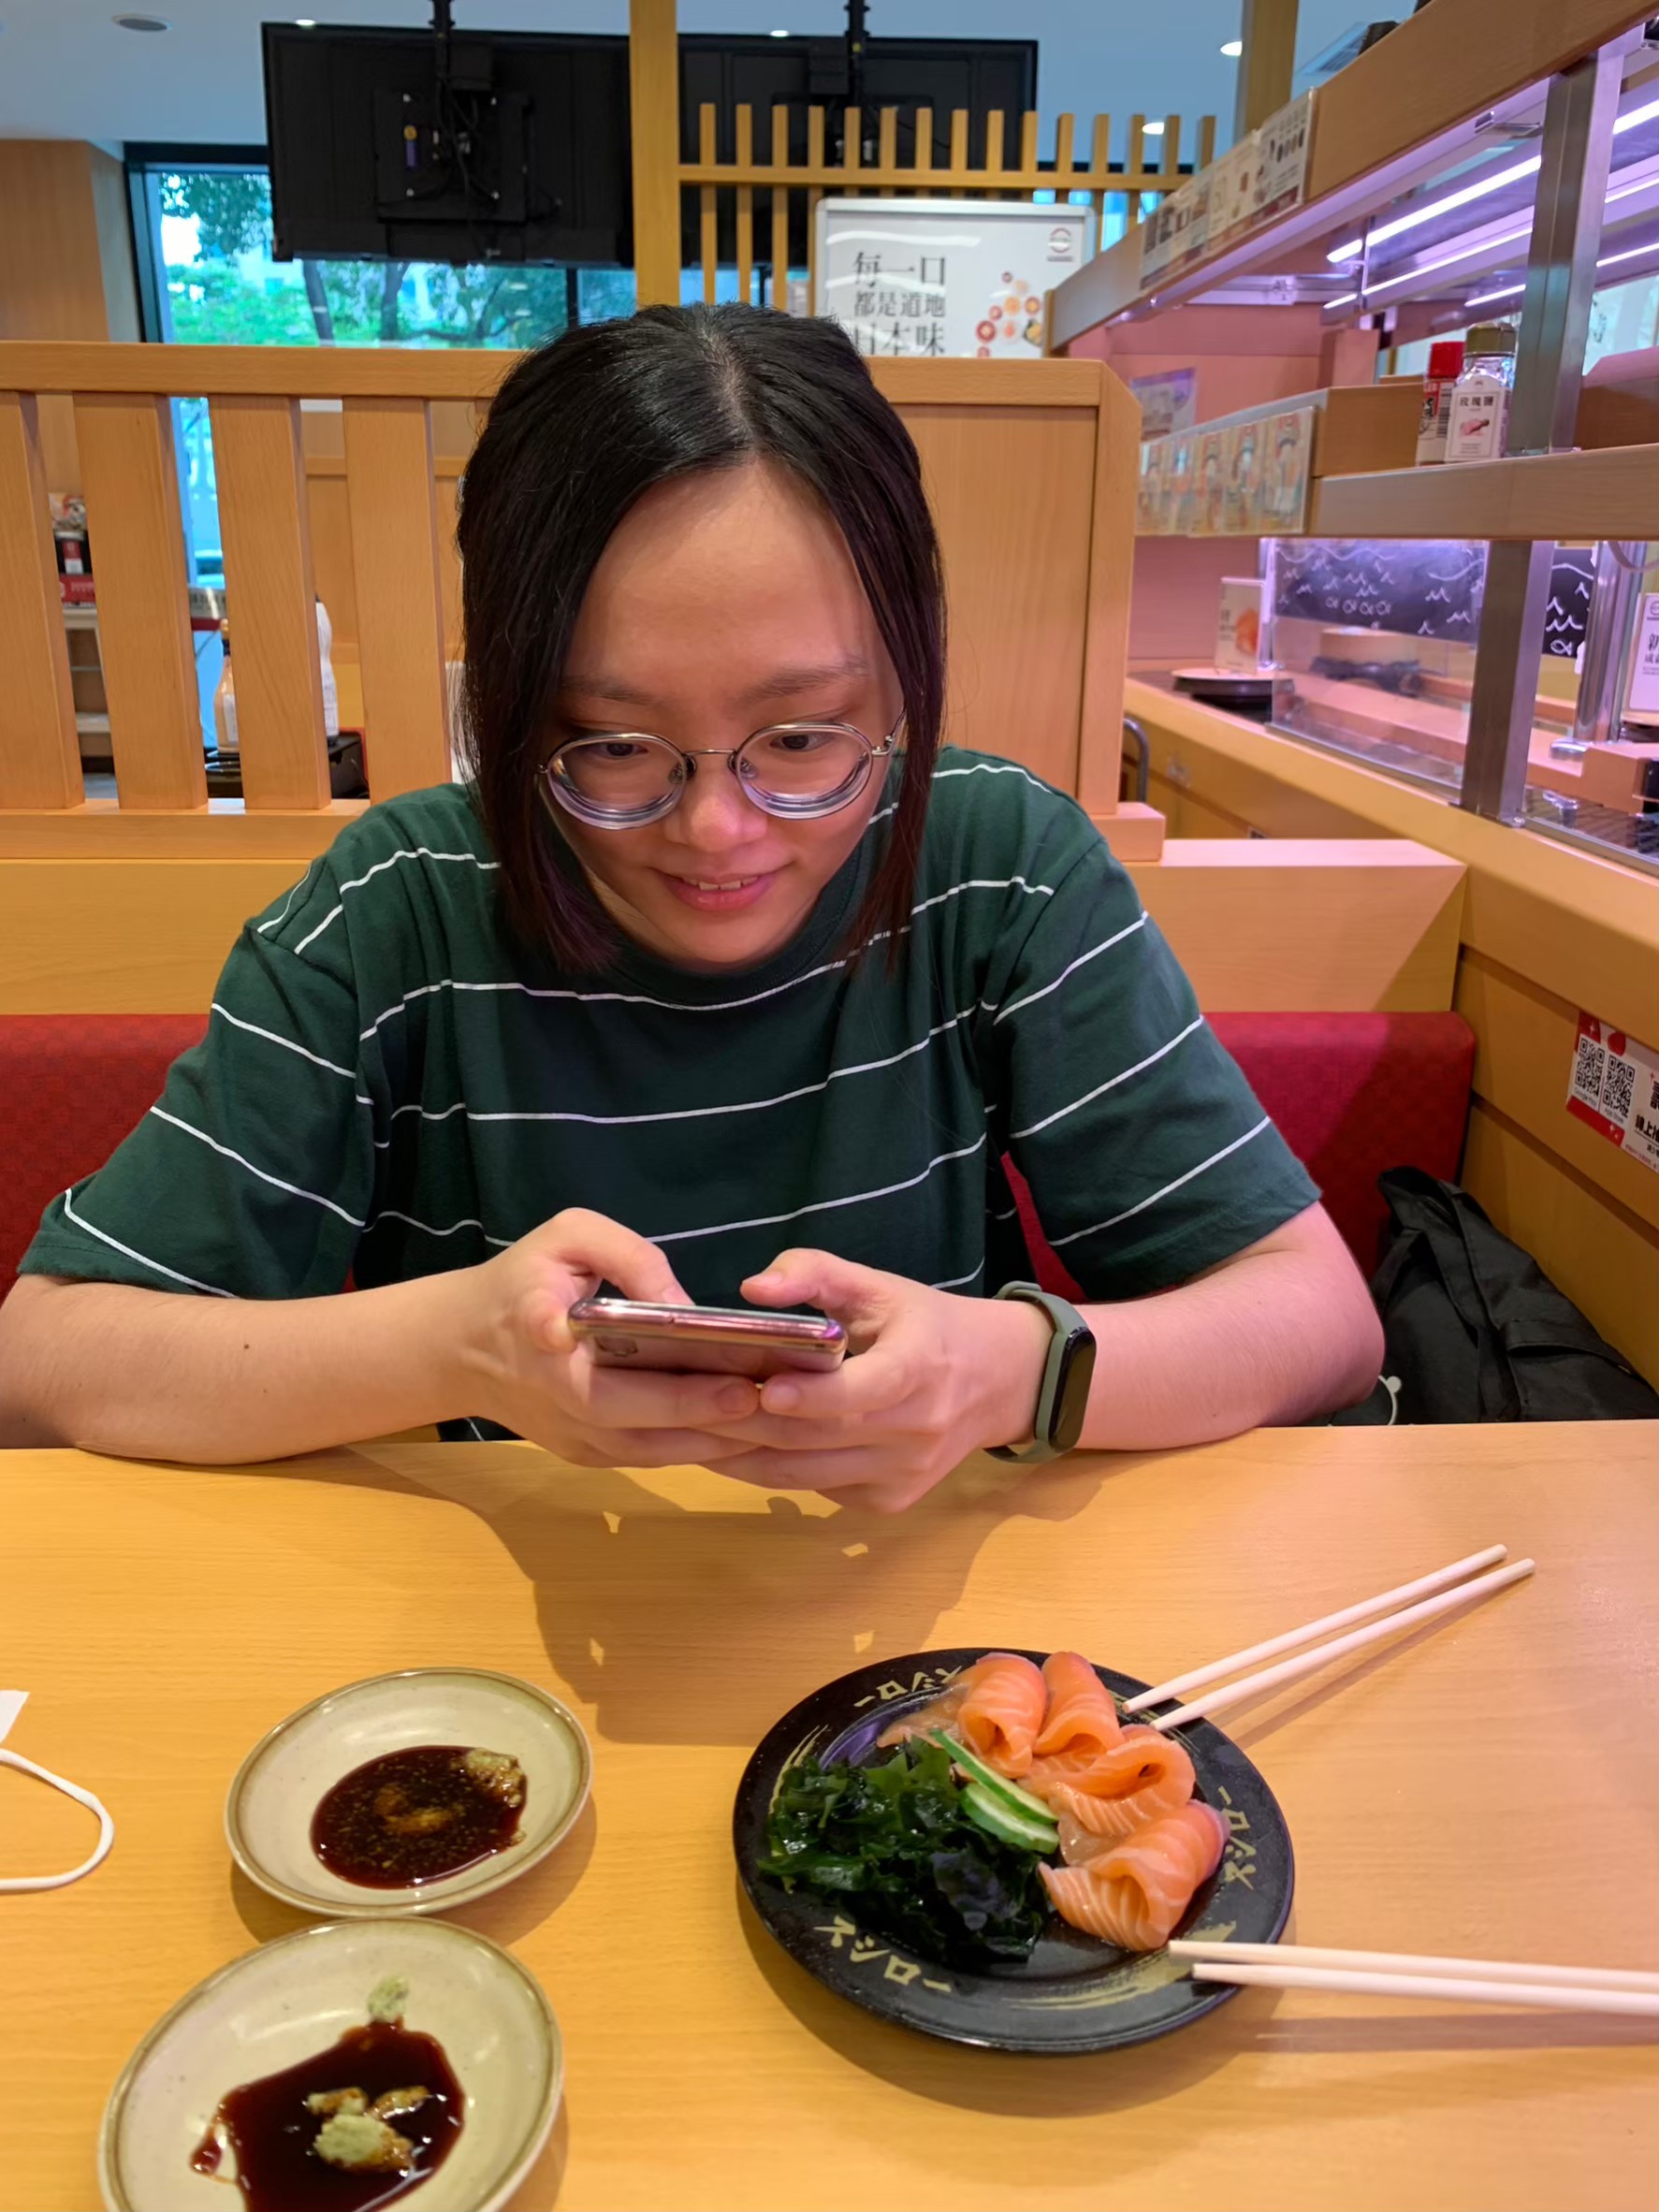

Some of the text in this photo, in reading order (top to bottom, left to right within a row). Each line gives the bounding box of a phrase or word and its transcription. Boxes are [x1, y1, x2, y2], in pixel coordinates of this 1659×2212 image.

[852, 252, 945, 287] 每一口
[854, 292, 945, 317] 都是道地
[853, 322, 944, 357] 日本味
[812, 1914, 952, 1993] スシロー
